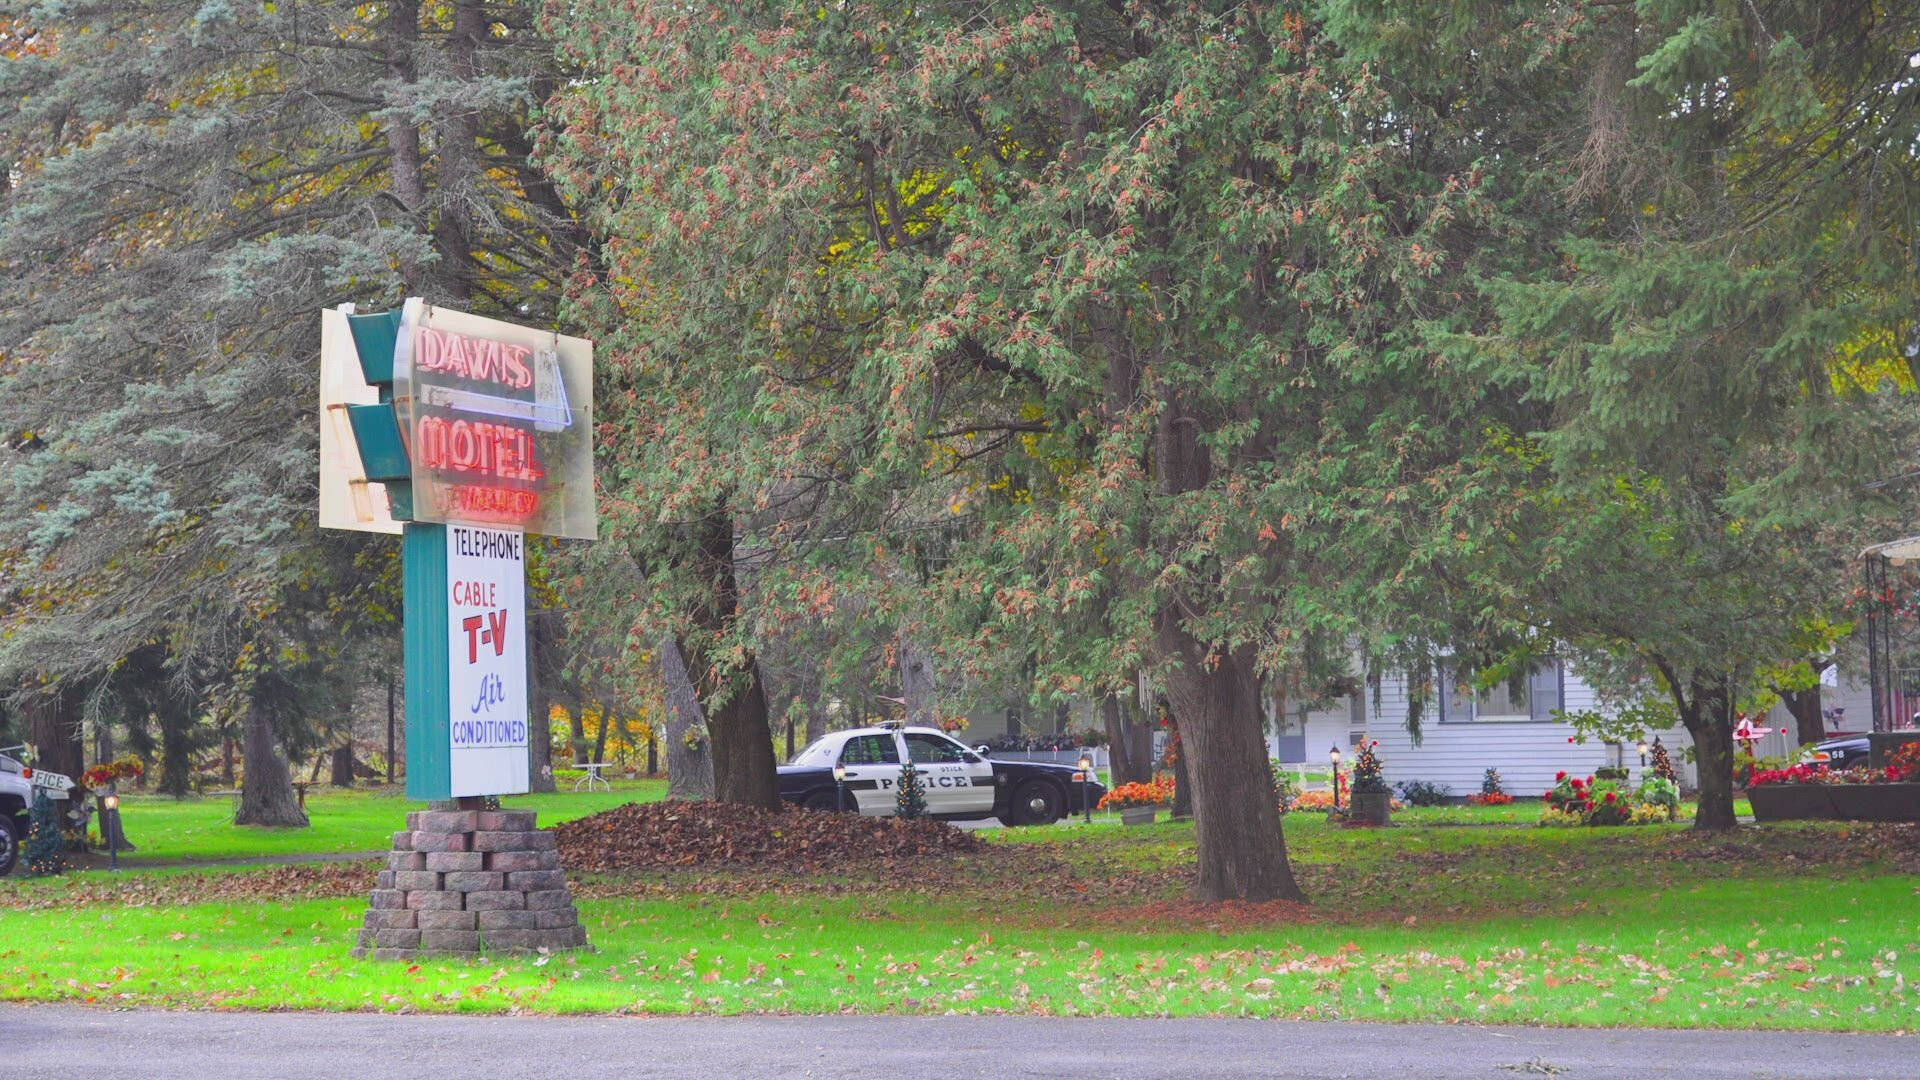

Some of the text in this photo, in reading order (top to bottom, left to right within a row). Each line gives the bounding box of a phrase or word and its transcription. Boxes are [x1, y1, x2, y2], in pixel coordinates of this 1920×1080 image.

[418, 415, 544, 481] MOTEL
[454, 528, 520, 560] TELEPHONE
[453, 581, 496, 607] CABLE
[471, 672, 505, 713] Air
[453, 721, 525, 743] CONDITIONED
[32, 770, 64, 789] FICE
